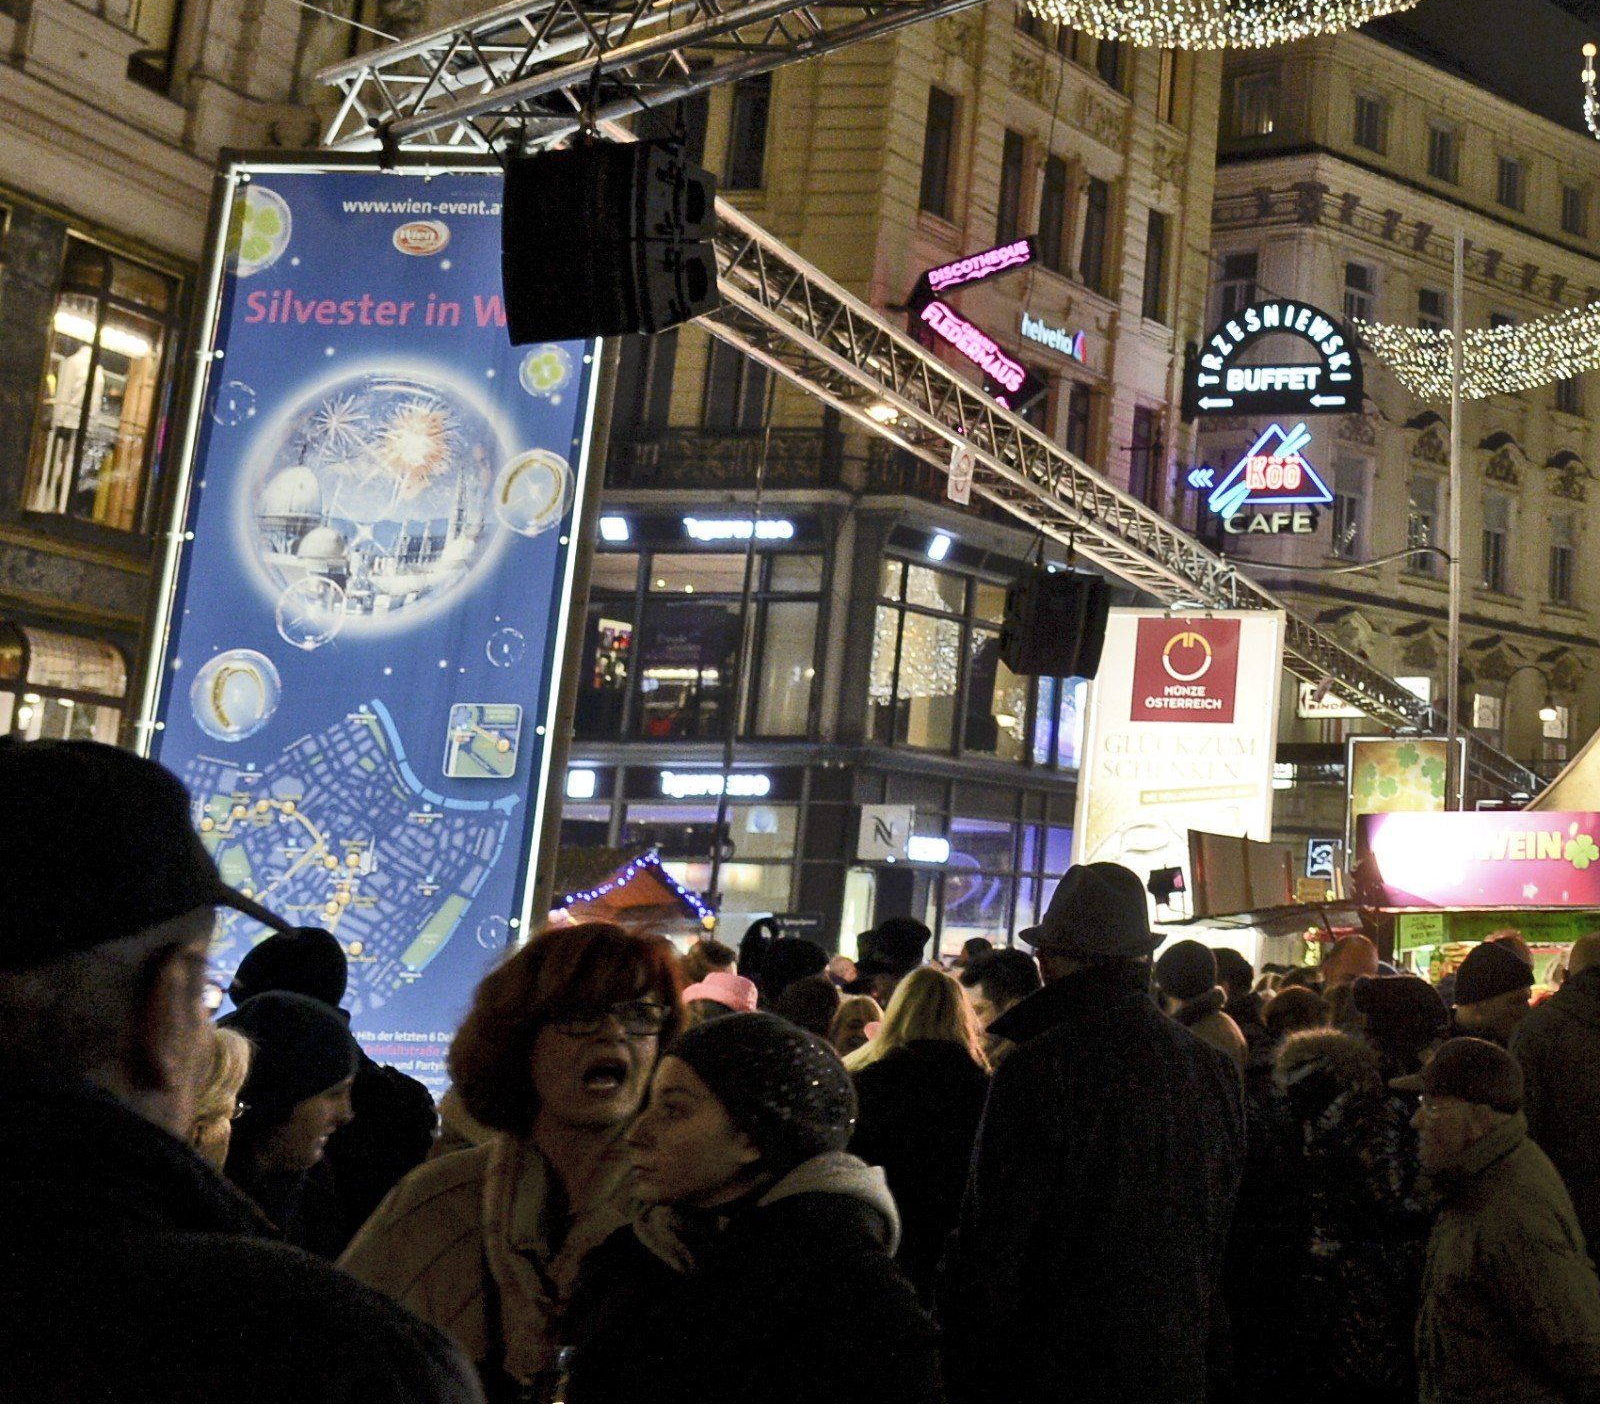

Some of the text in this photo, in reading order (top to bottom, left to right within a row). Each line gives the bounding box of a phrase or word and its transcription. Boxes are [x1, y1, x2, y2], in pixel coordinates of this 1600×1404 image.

[342, 198, 502, 216] www.wien-event.a
[928, 240, 1030, 286] DISCOTHEQUE
[245, 289, 415, 326] Silvester
[425, 293, 461, 327] in
[1021, 311, 1073, 355] helvetia
[920, 302, 1024, 393] FLEDERMAUS
[1226, 366, 1322, 392] BUFFET
[1223, 511, 1314, 534] CAFE
[1145, 696, 1222, 710] ÖSTERREICH
[1164, 685, 1206, 697] MÜNZE
[357, 1030, 428, 1042] Hits der letzten
